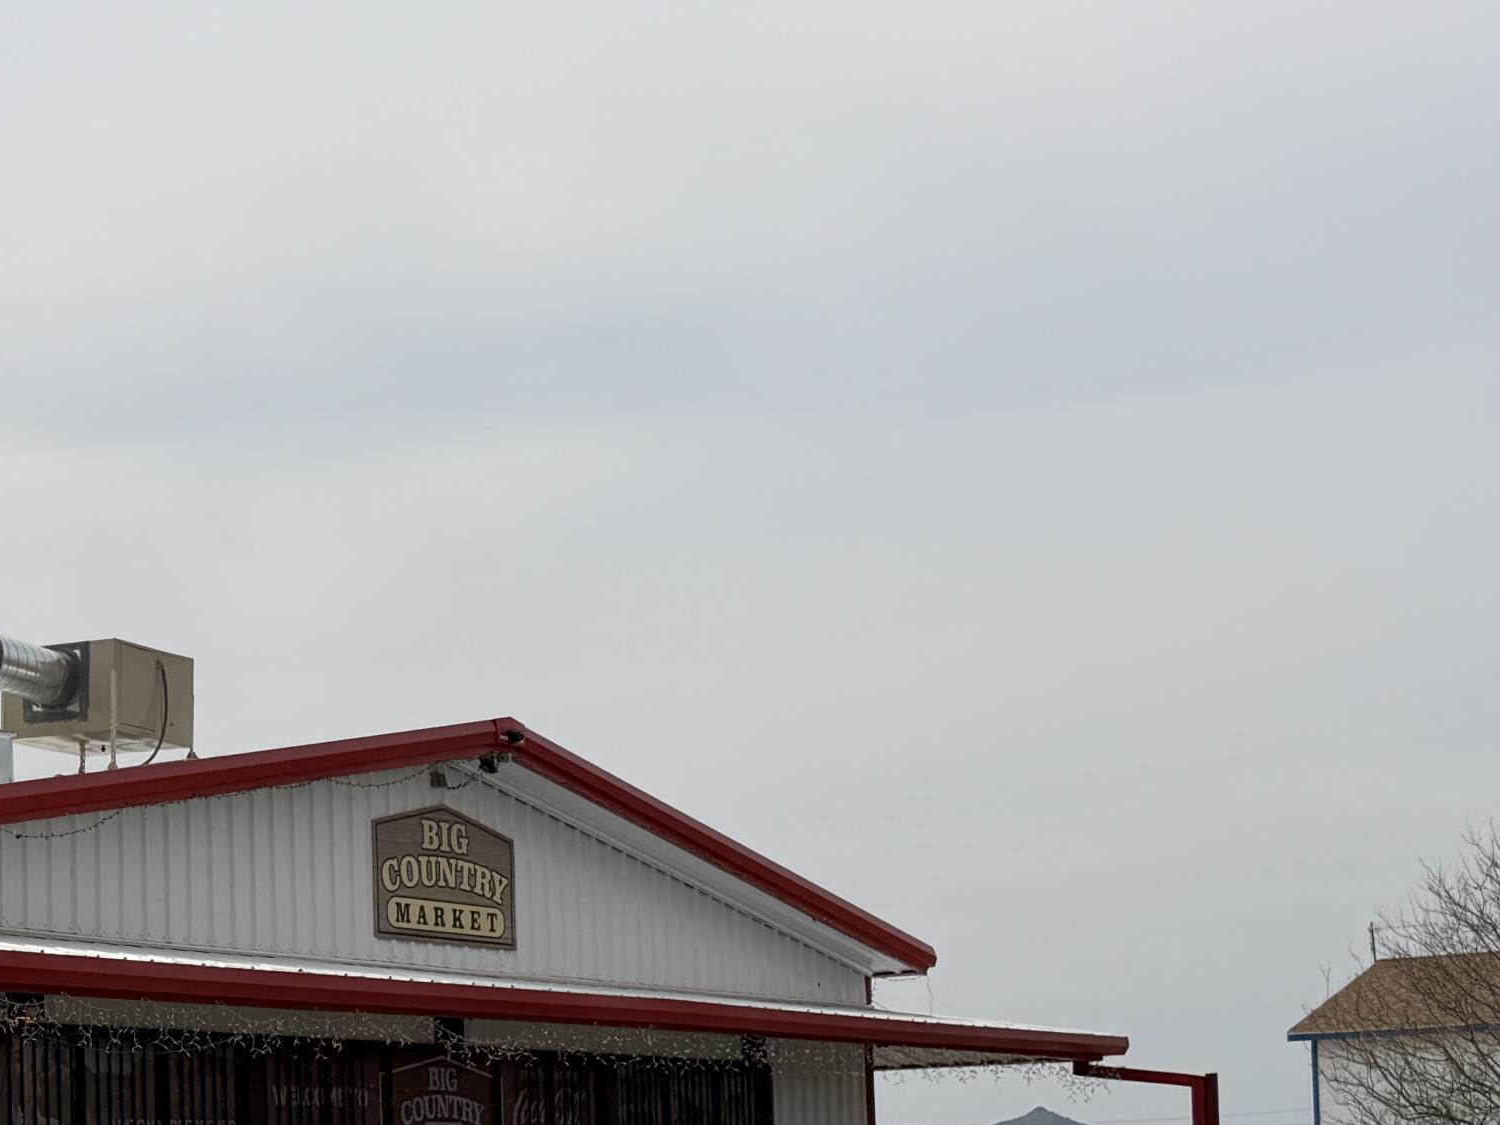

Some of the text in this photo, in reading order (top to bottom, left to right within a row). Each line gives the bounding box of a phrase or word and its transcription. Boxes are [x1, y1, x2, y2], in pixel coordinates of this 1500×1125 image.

[421, 818, 469, 855] BIG
[381, 856, 509, 905] COUNTRY
[394, 902, 498, 933] MARKET
[427, 1066, 458, 1092] BIG
